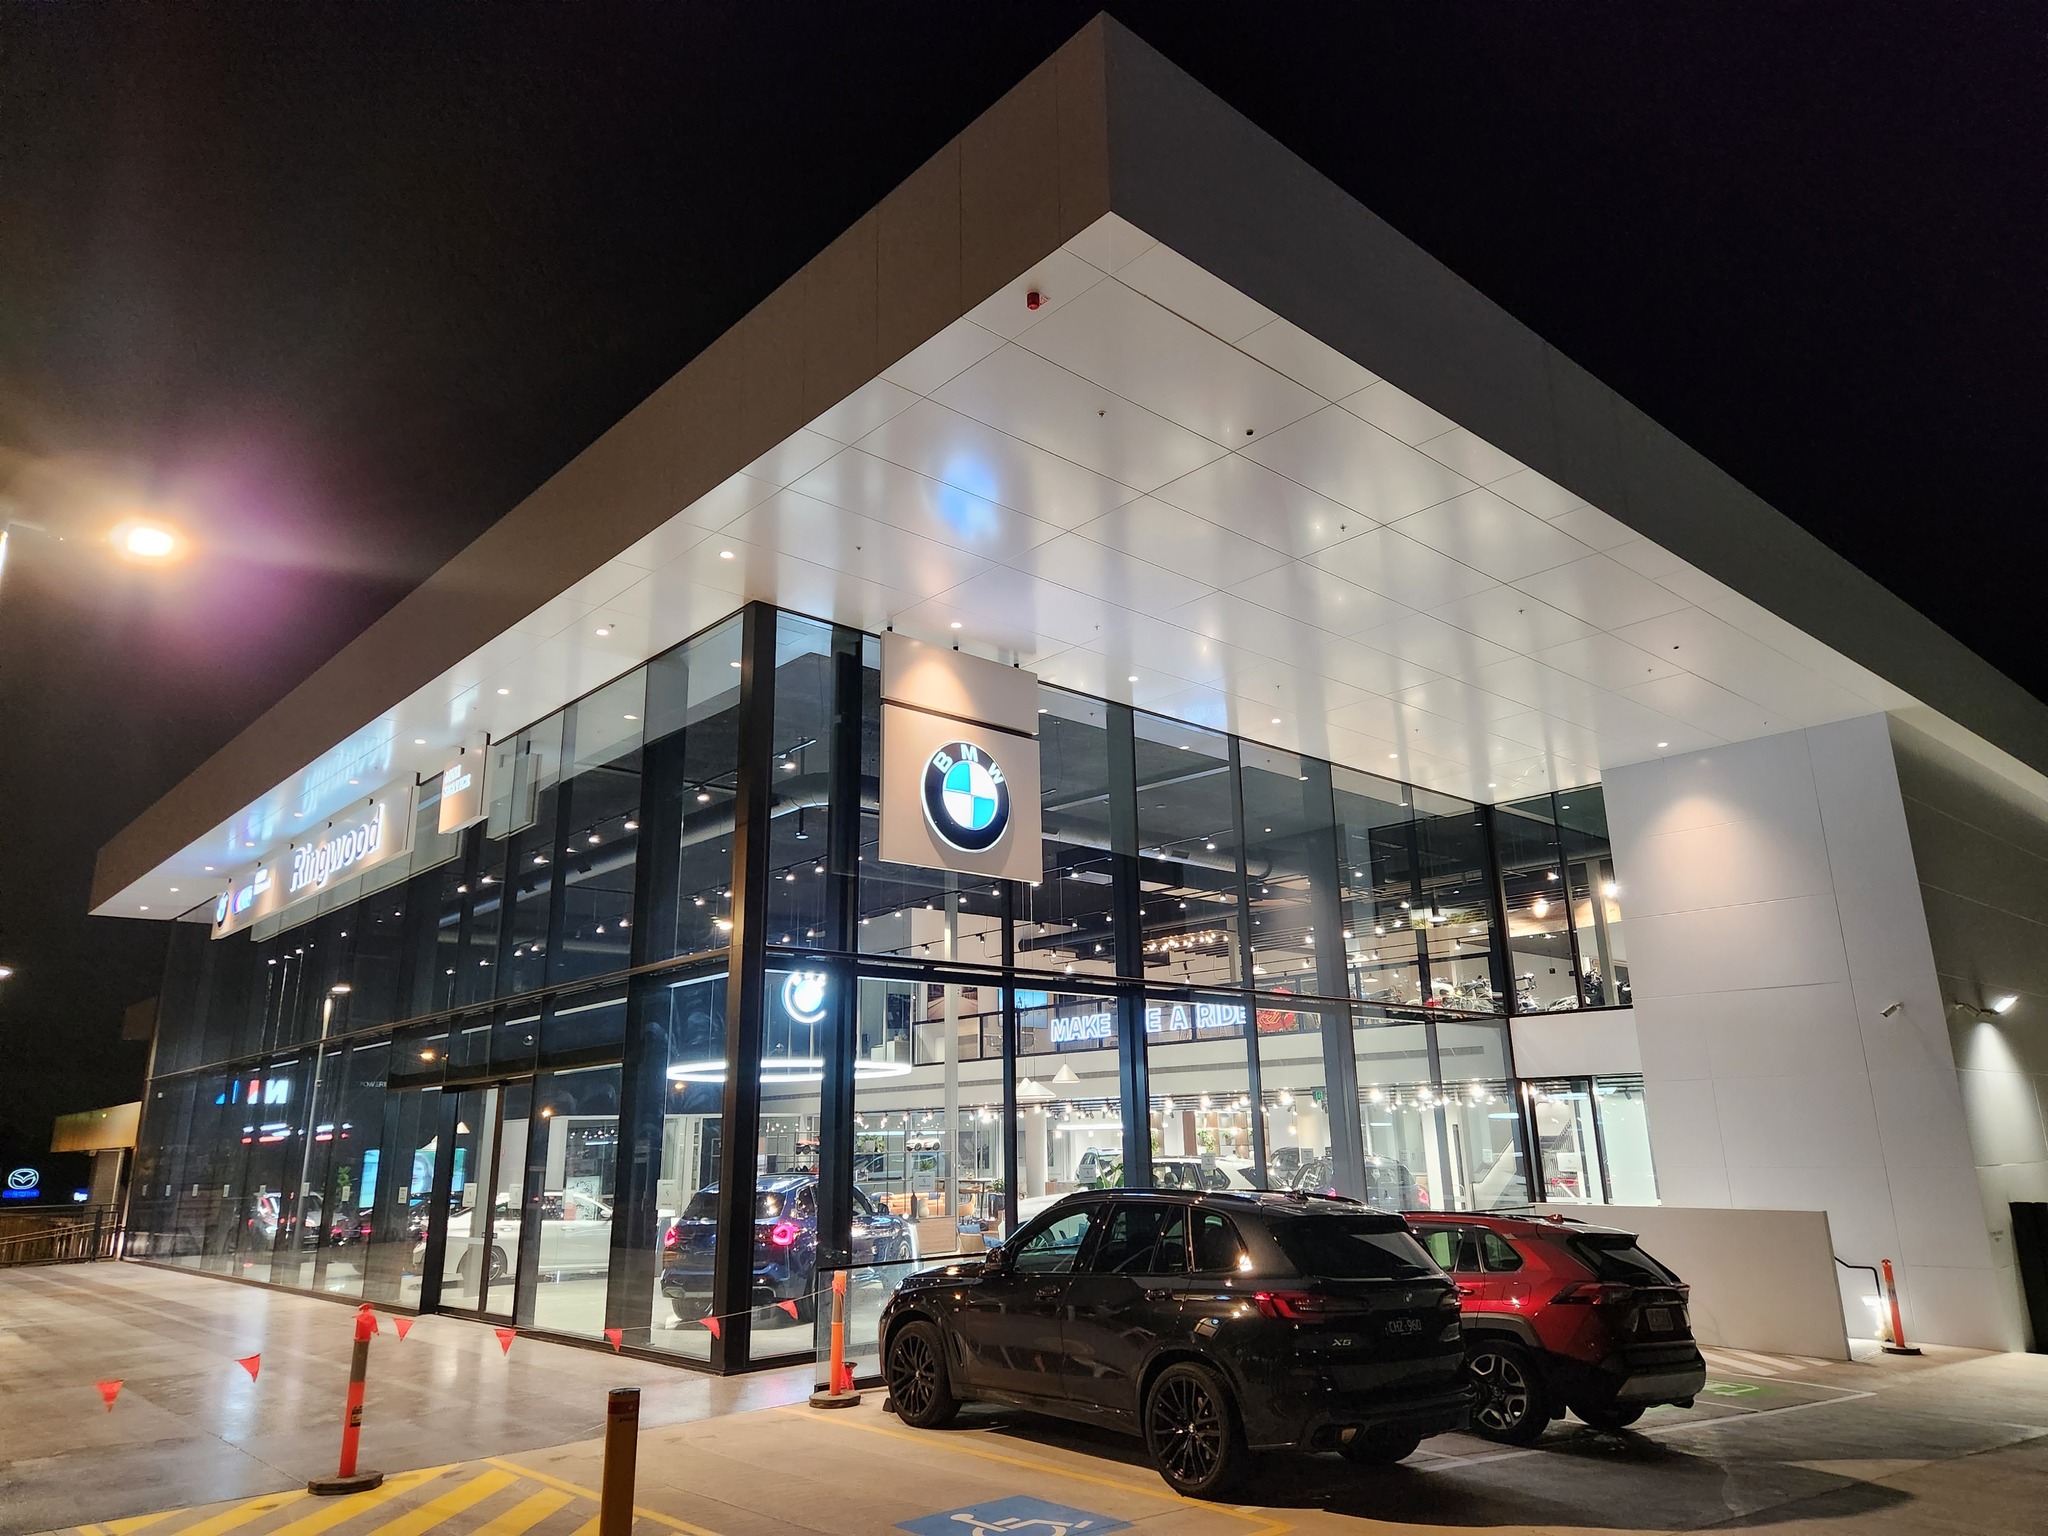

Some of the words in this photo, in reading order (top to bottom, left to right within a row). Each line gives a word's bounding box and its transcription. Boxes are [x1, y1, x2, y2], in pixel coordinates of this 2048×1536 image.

[932, 743, 1005, 785] BMW
[289, 803, 386, 892] Ringwood
[1050, 1012, 1112, 1043] MAKE
[1169, 1005, 1188, 1031] A
